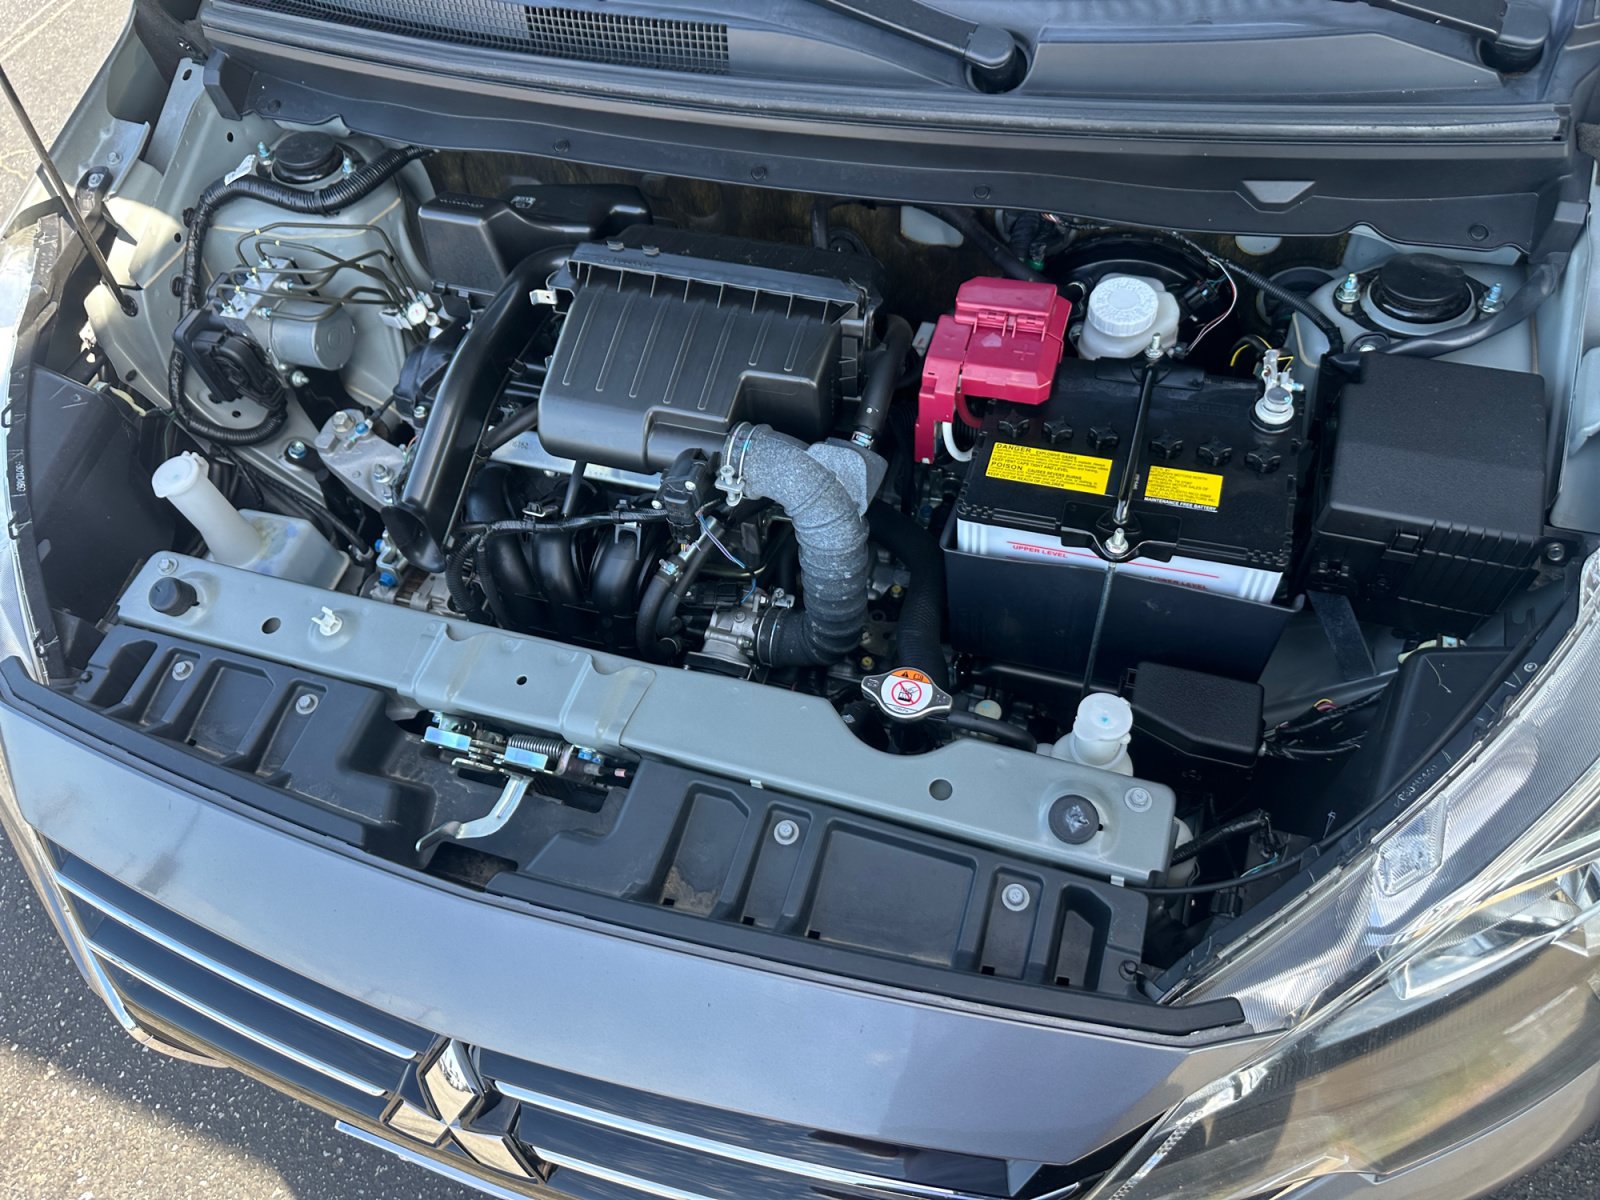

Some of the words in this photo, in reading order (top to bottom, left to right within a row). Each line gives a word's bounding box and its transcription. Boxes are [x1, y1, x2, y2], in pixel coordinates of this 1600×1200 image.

[996, 444, 1031, 453] DANGER
[991, 461, 1023, 471] POISON
[1144, 496, 1180, 506] MAINTENANCE
[1012, 545, 1040, 554] UPPER
[1041, 550, 1068, 558] LEVEL
